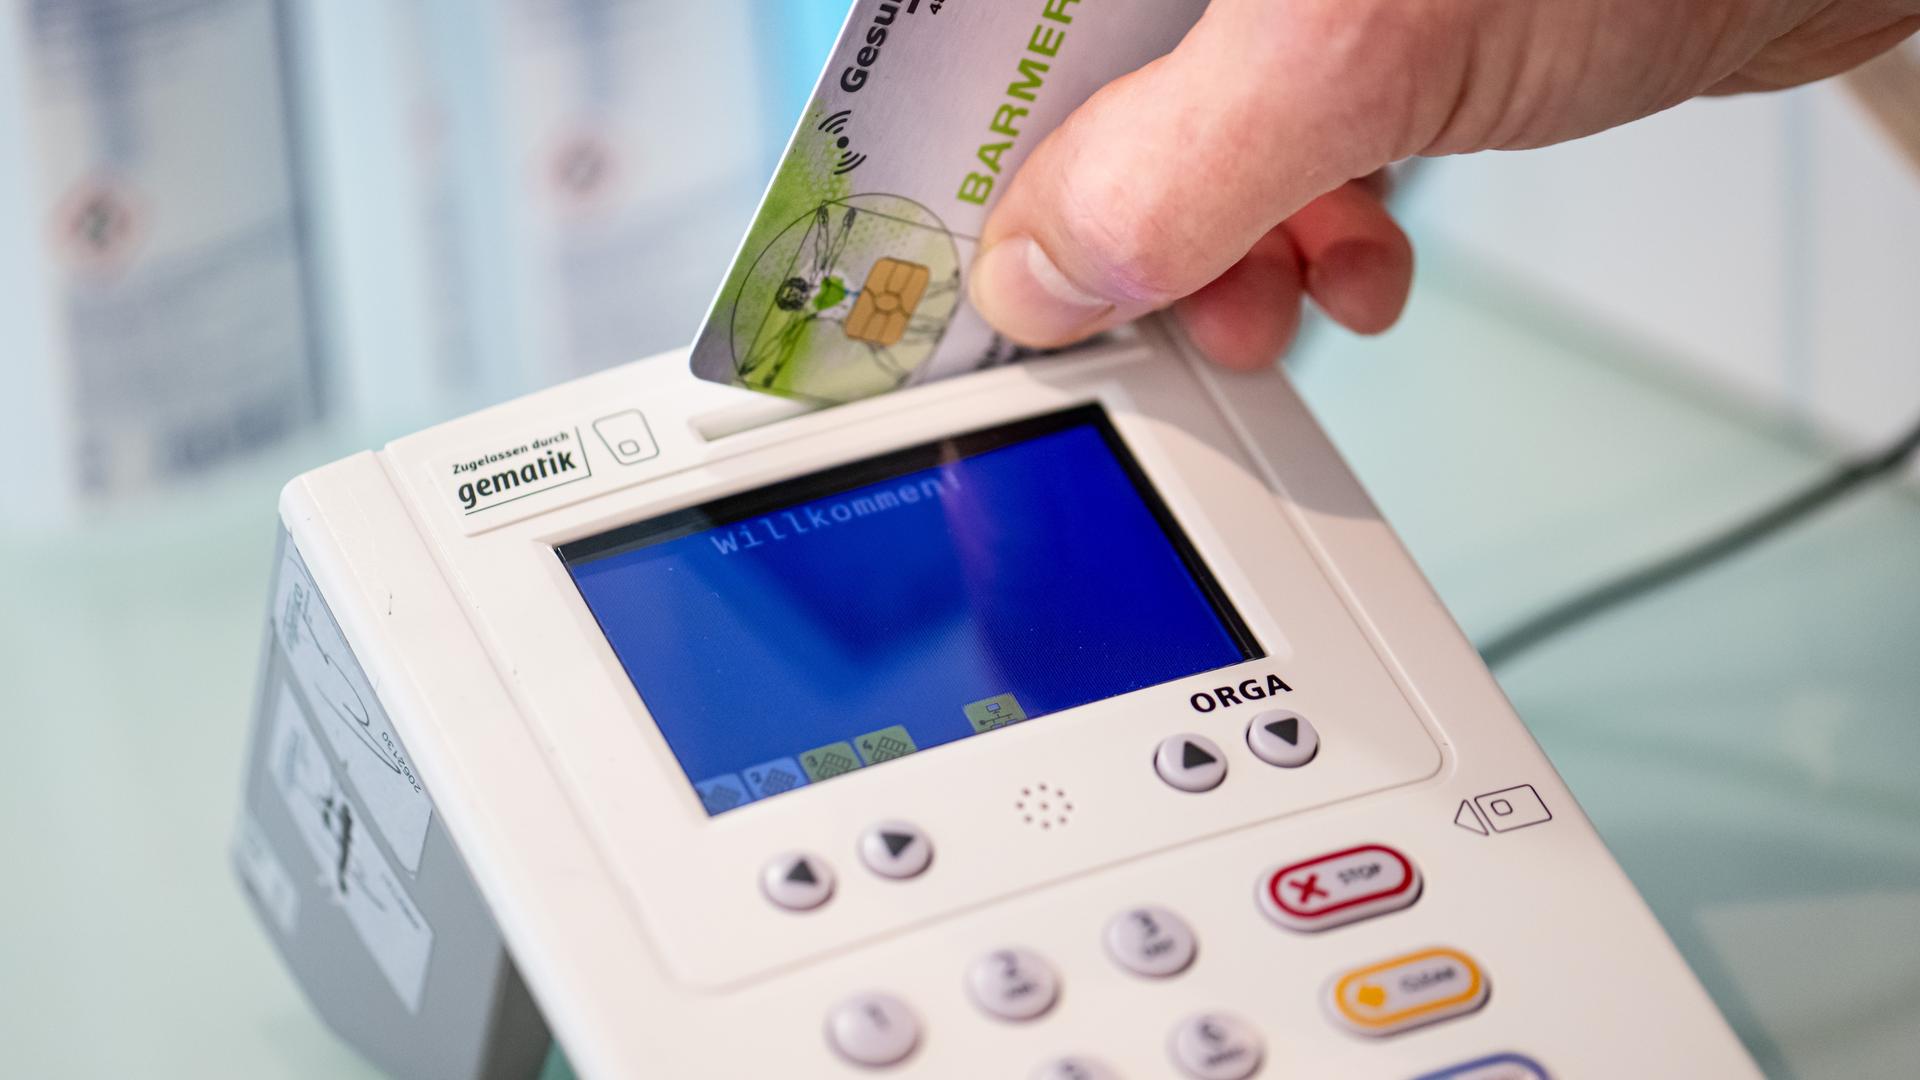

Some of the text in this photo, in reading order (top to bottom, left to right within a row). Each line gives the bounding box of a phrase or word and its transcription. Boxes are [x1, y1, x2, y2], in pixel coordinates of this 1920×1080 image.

[840, 0, 901, 92] Gesu
[453, 431, 570, 475] Zugelassen durch
[458, 450, 577, 510] gematik
[1190, 674, 1293, 713] ORGA
[1337, 863, 1382, 885] STOP
